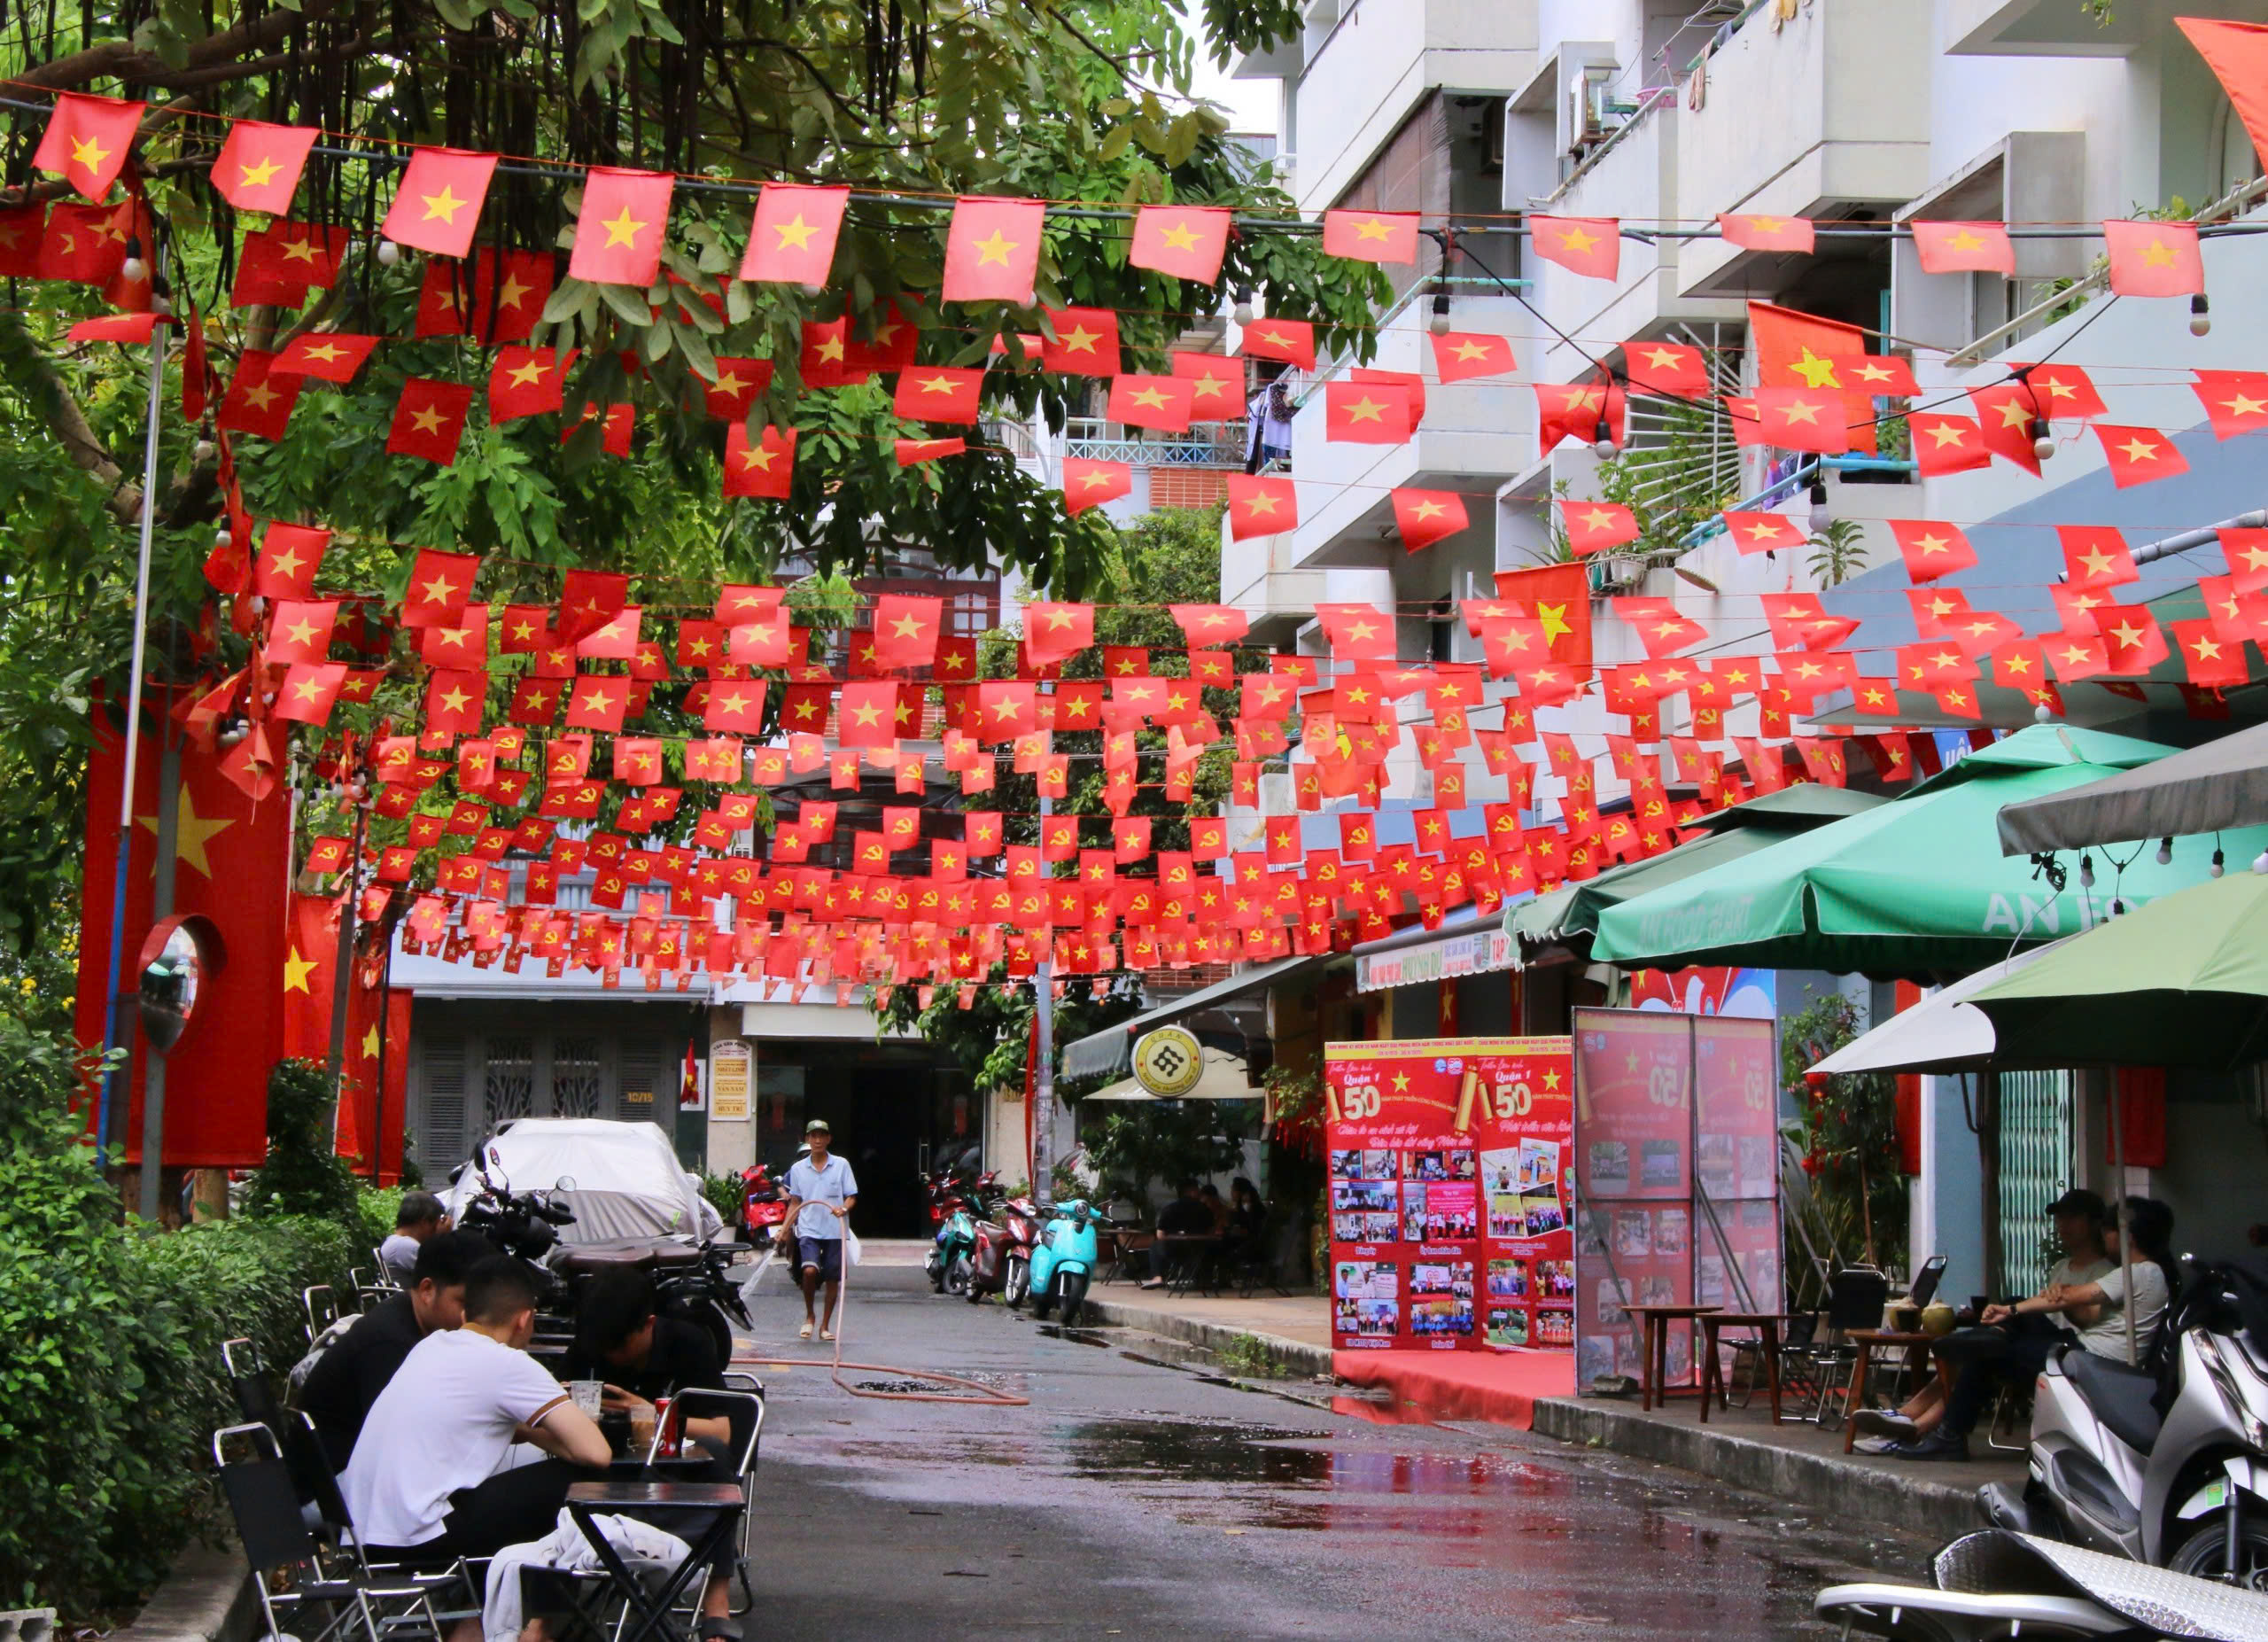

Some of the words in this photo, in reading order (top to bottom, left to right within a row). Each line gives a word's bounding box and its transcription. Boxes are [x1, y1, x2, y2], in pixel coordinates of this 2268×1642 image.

[1982, 892, 2060, 933] AN
[1375, 1071, 1380, 1082] 1
[1526, 1070, 1531, 1079] 1
[1344, 1086, 1381, 1120] 50
[1495, 1083, 1532, 1118] 50
